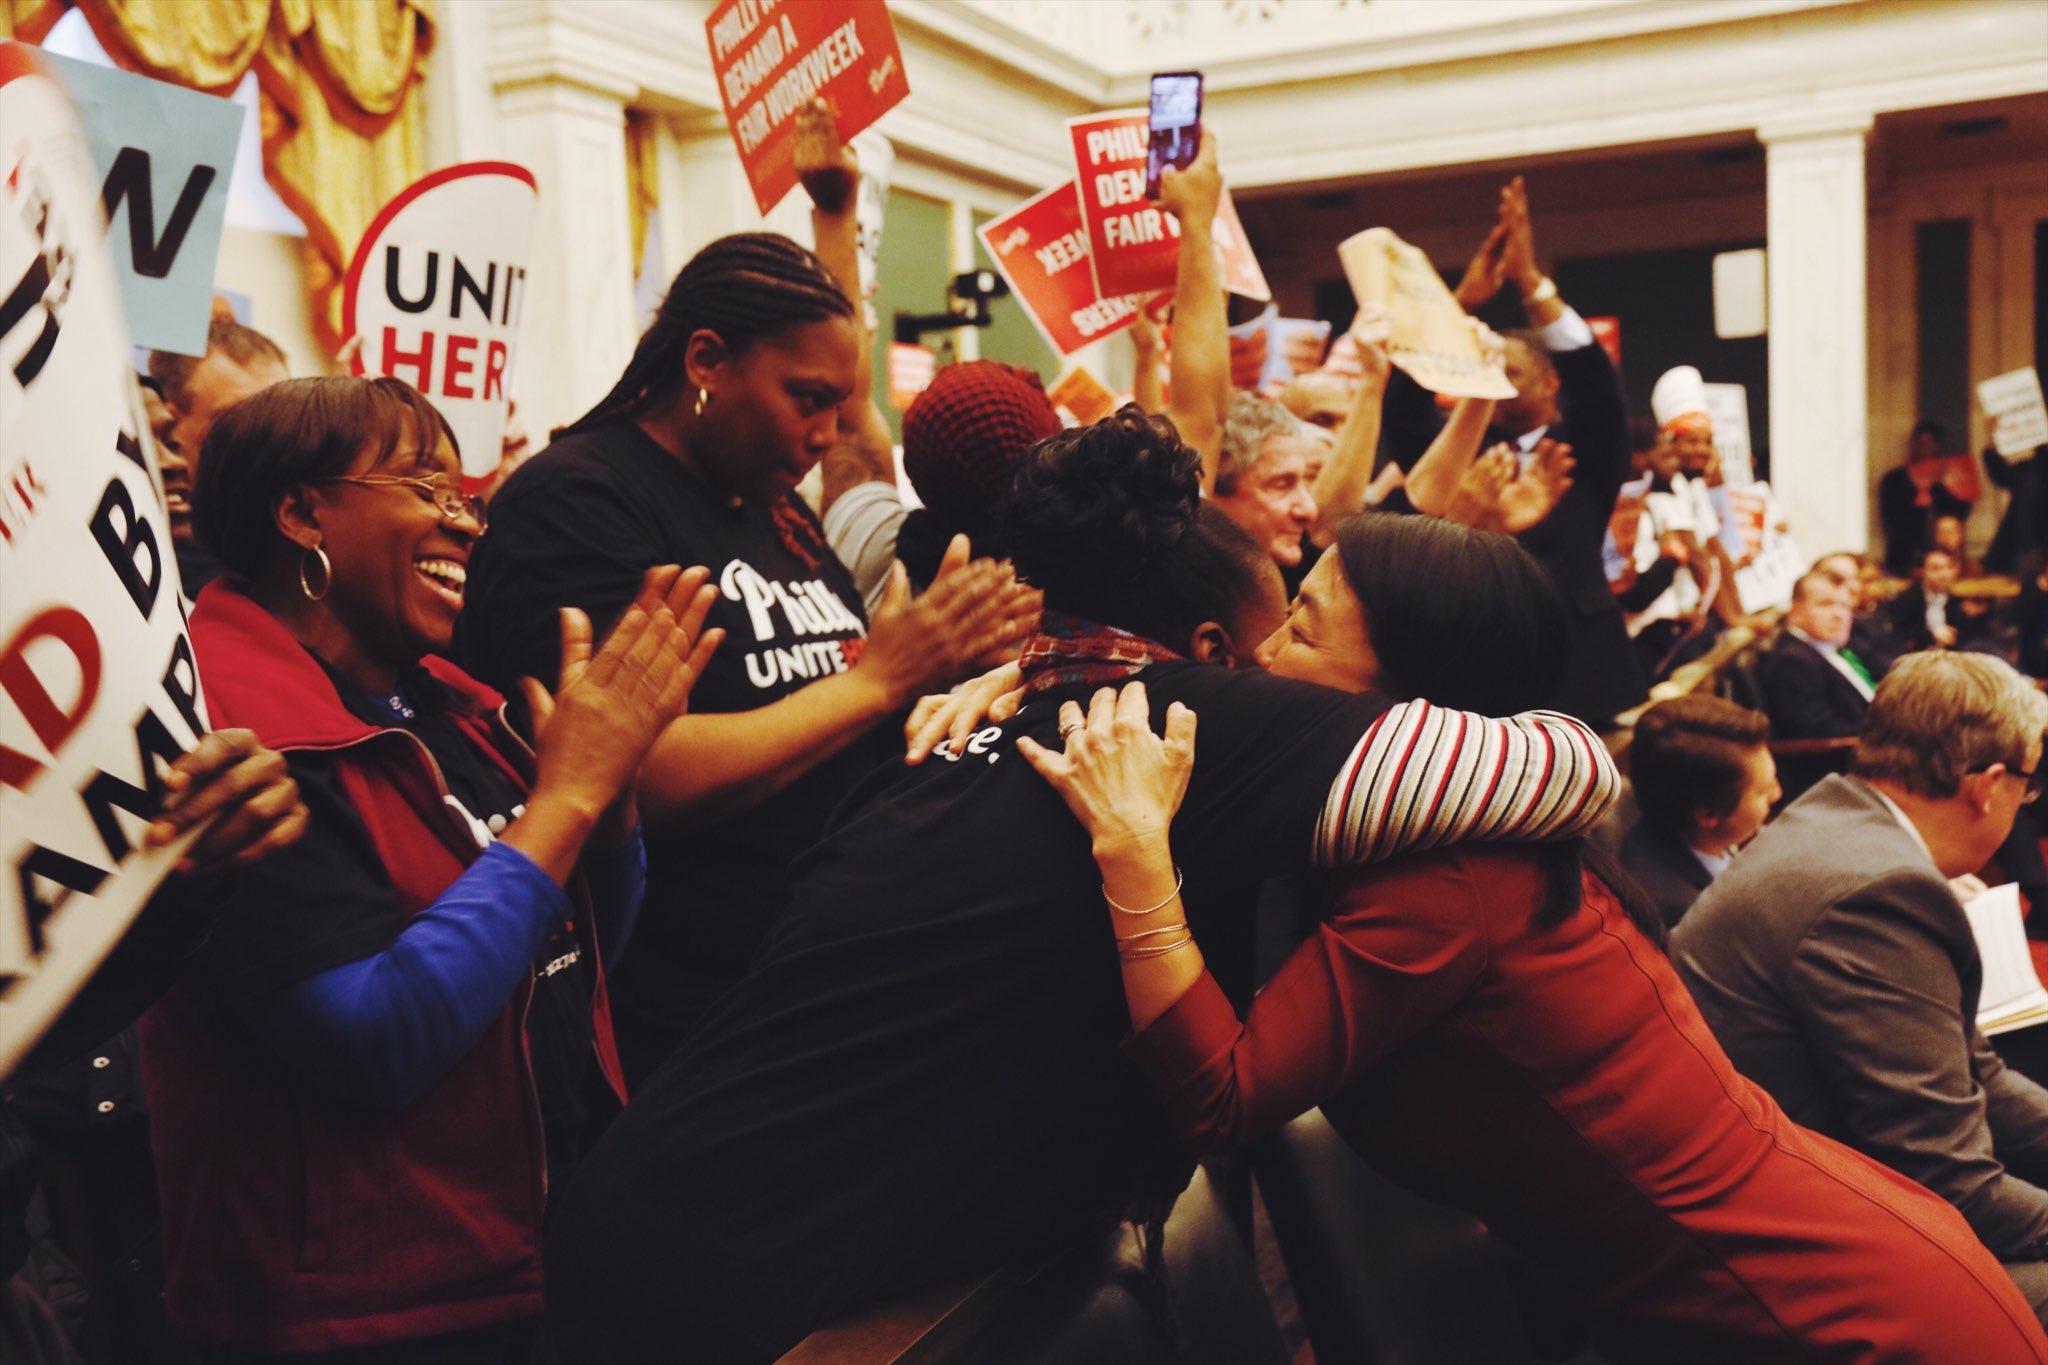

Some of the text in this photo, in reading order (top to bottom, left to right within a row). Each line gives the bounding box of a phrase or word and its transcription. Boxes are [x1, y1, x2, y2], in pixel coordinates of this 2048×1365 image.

[723, 13, 799, 110] DEMAND A
[736, 99, 773, 156] FAIR
[763, 17, 865, 127] WORKWEEK
[1103, 208, 1164, 250] FAIR
